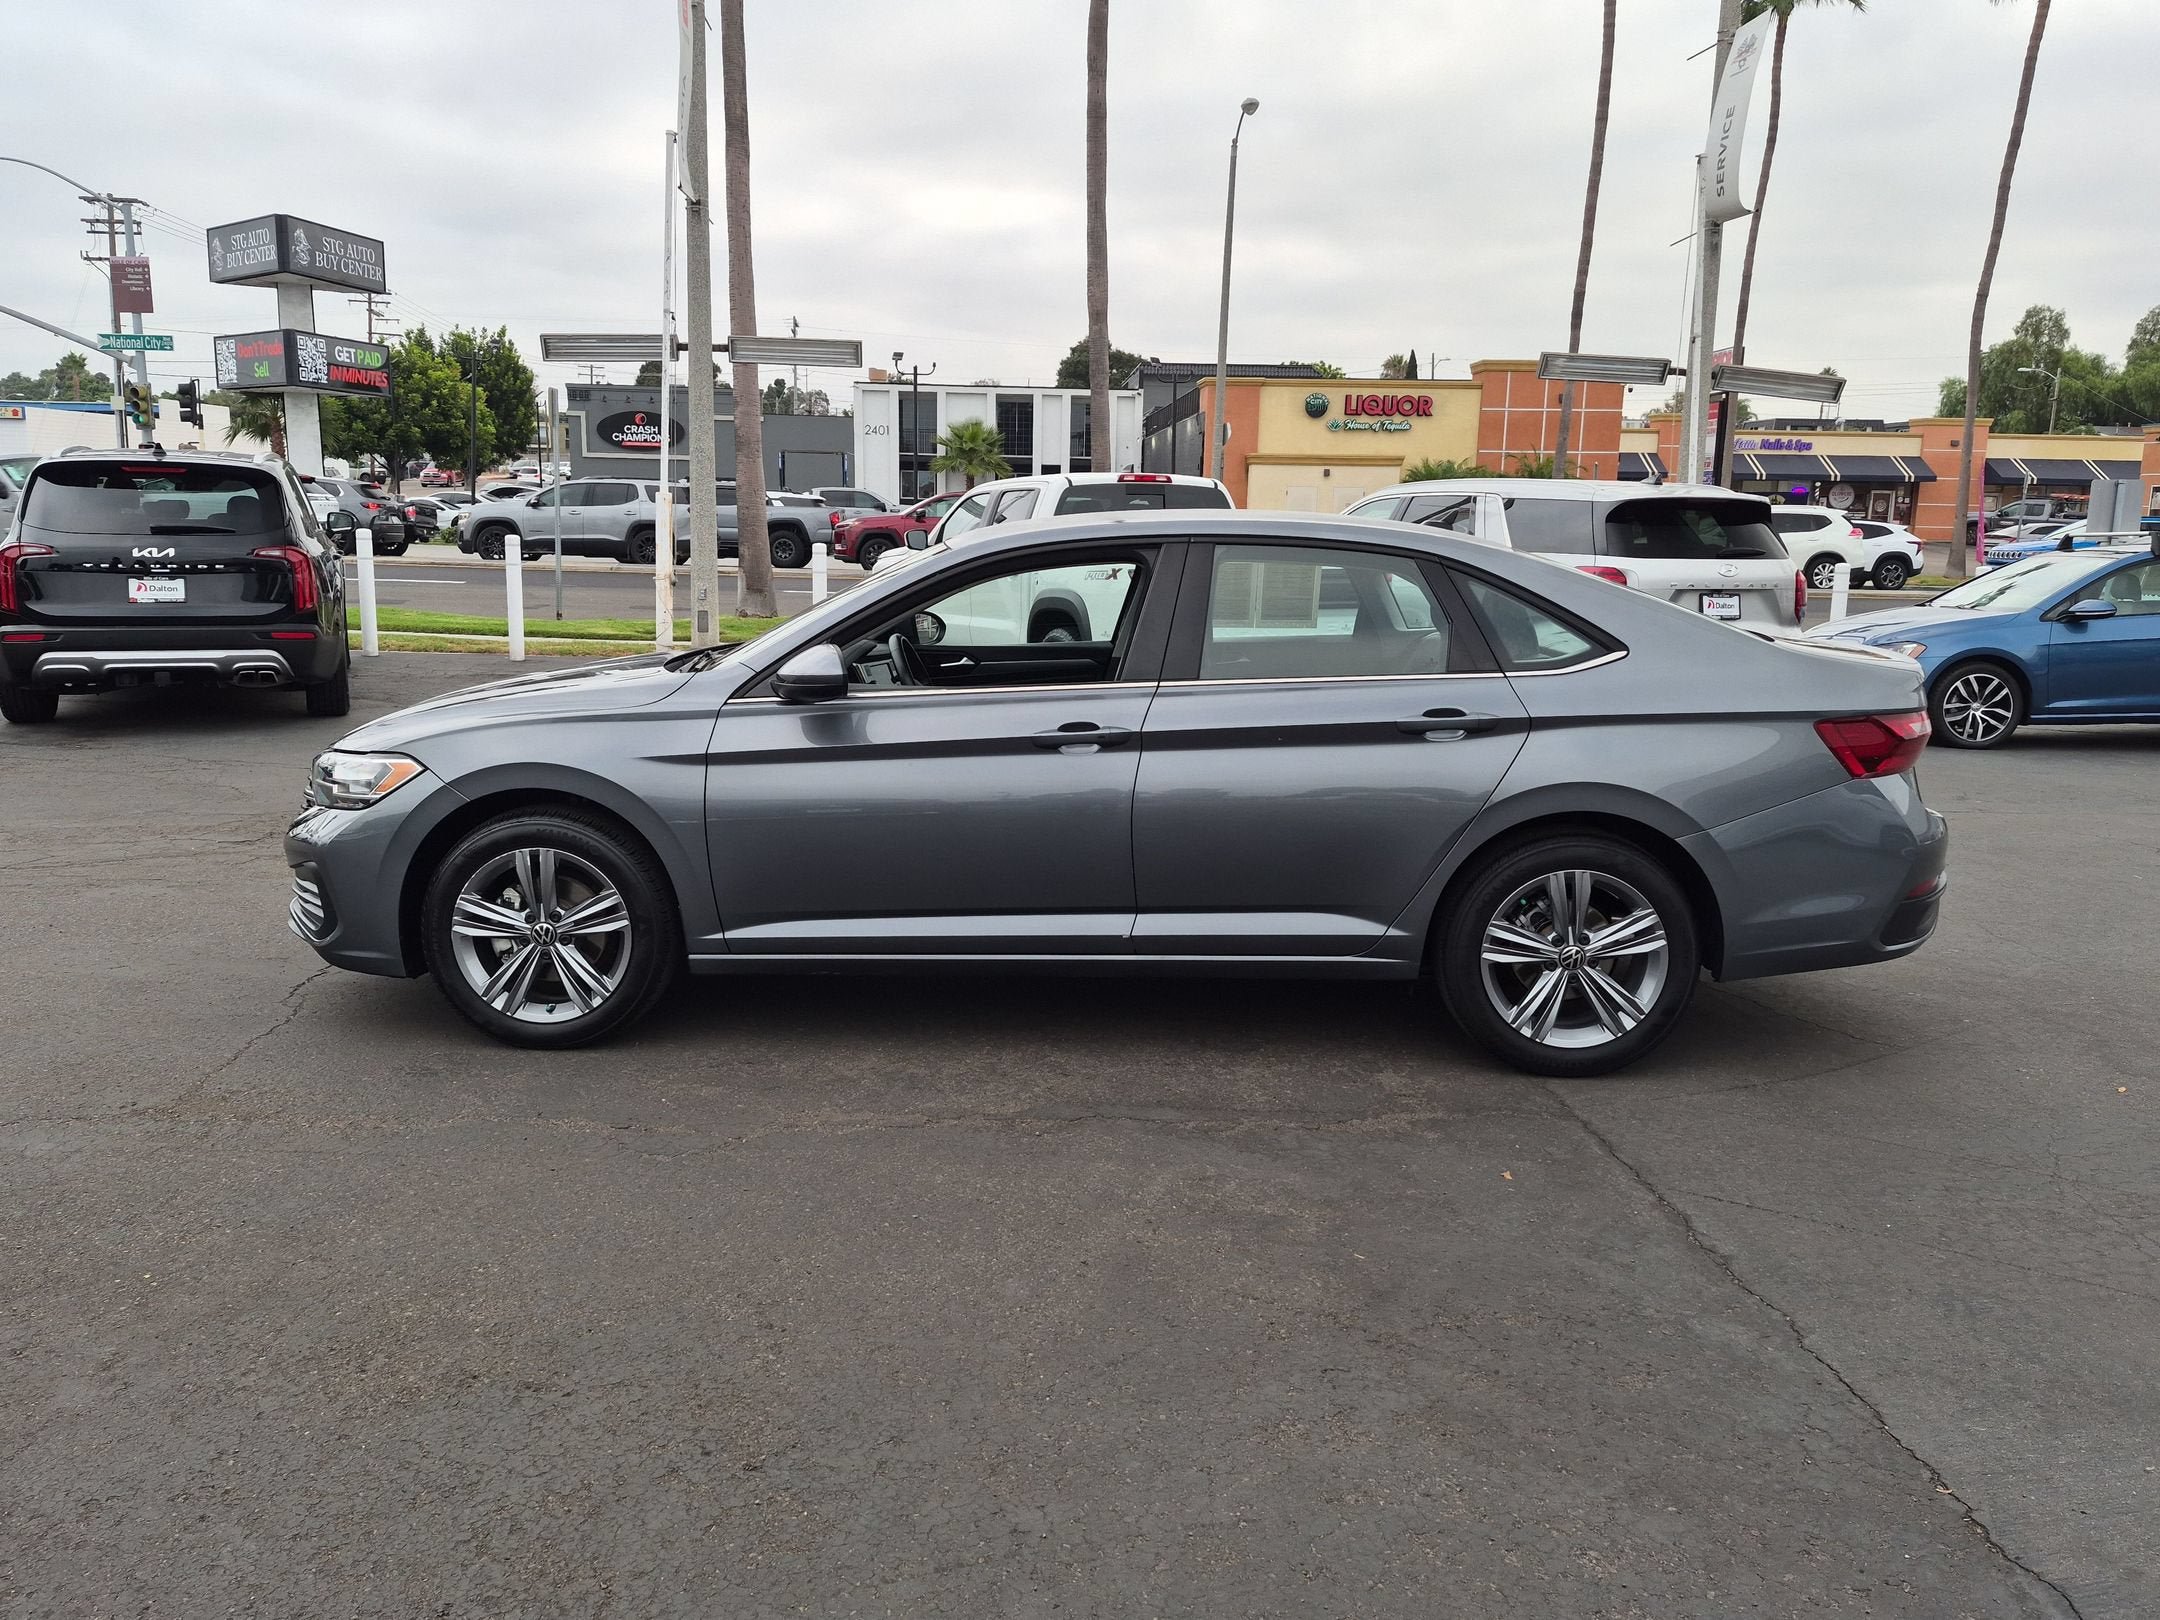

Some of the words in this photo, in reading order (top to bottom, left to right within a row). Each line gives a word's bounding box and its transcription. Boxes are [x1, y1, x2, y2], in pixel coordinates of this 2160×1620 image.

[1716, 104, 1736, 198] SERVICE
[231, 233, 247, 250] STG
[248, 228, 270, 247] AUTO
[226, 251, 244, 268] BUY
[244, 244, 277, 265] CENTER
[322, 236, 344, 255] STG
[346, 243, 375, 263] AUTO
[315, 251, 339, 271] BUY
[341, 258, 383, 282] CENTER
[110, 336, 143, 348] National
[144, 336, 161, 350] City
[334, 345, 356, 363] GET
[356, 349, 382, 368] PAID
[254, 361, 270, 378] Sell
[330, 365, 342, 380] IN
[342, 367, 389, 388] MINUTES
[1344, 394, 1433, 417] LIQUOR
[623, 425, 659, 434] CRASH
[864, 424, 890, 436] 2401
[1344, 419, 1370, 431] House
[1370, 420, 1381, 432] of
[1382, 420, 1412, 433] Tequila
[612, 432, 671, 443] CHAMPION
[1760, 438, 1785, 450] Nails
[1785, 438, 1793, 451] &
[1793, 438, 1813, 453] Spa
[149, 584, 178, 592] Dalton
[1715, 602, 1735, 610] Dalton
